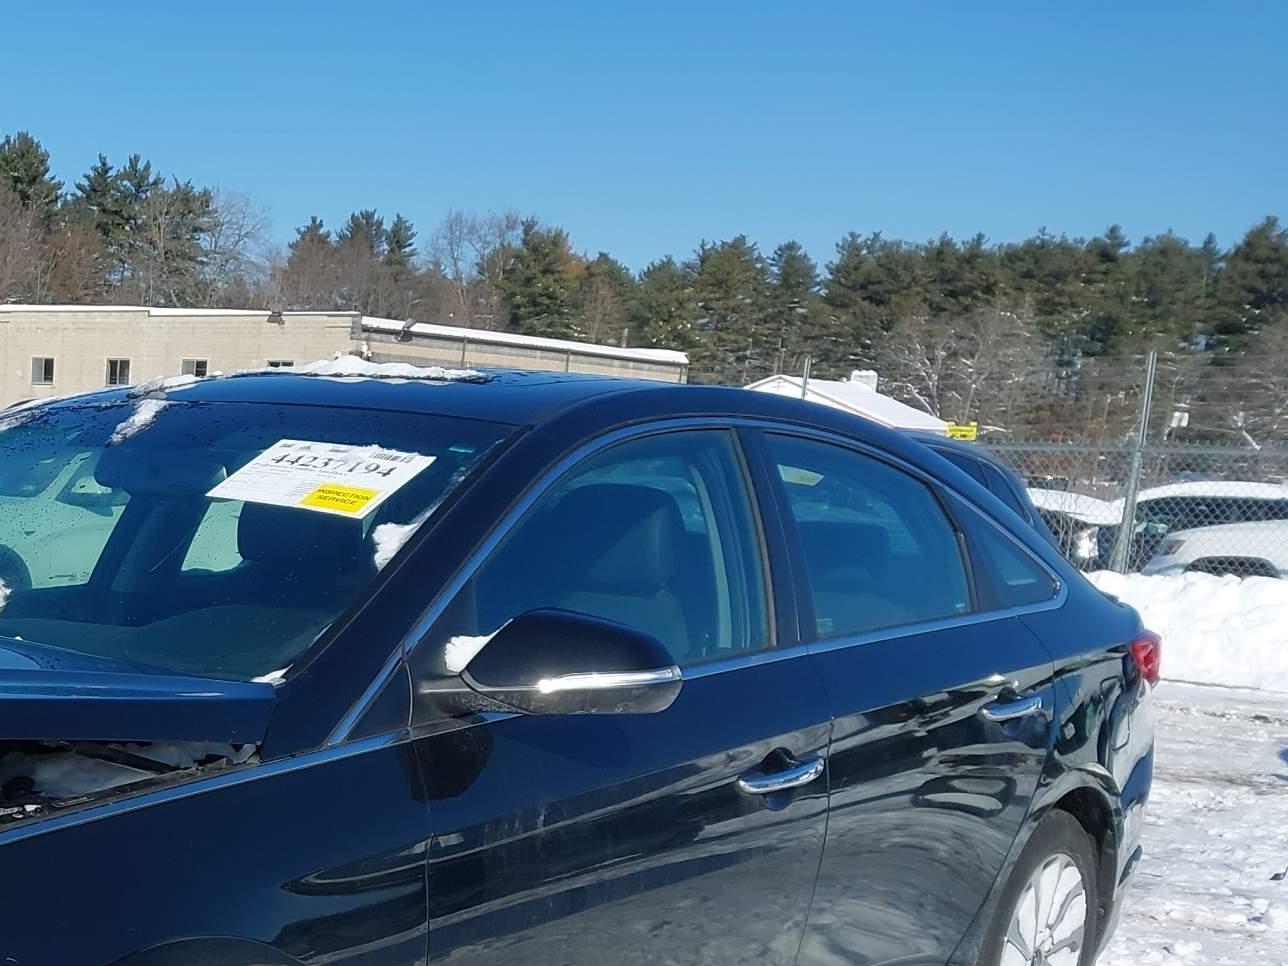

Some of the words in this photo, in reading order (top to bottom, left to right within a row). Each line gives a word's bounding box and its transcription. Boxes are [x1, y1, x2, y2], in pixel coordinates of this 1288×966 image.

[271, 453, 397, 477] 44237194
[316, 493, 358, 506] SERVICE
[318, 487, 373, 502] INSPECTION
